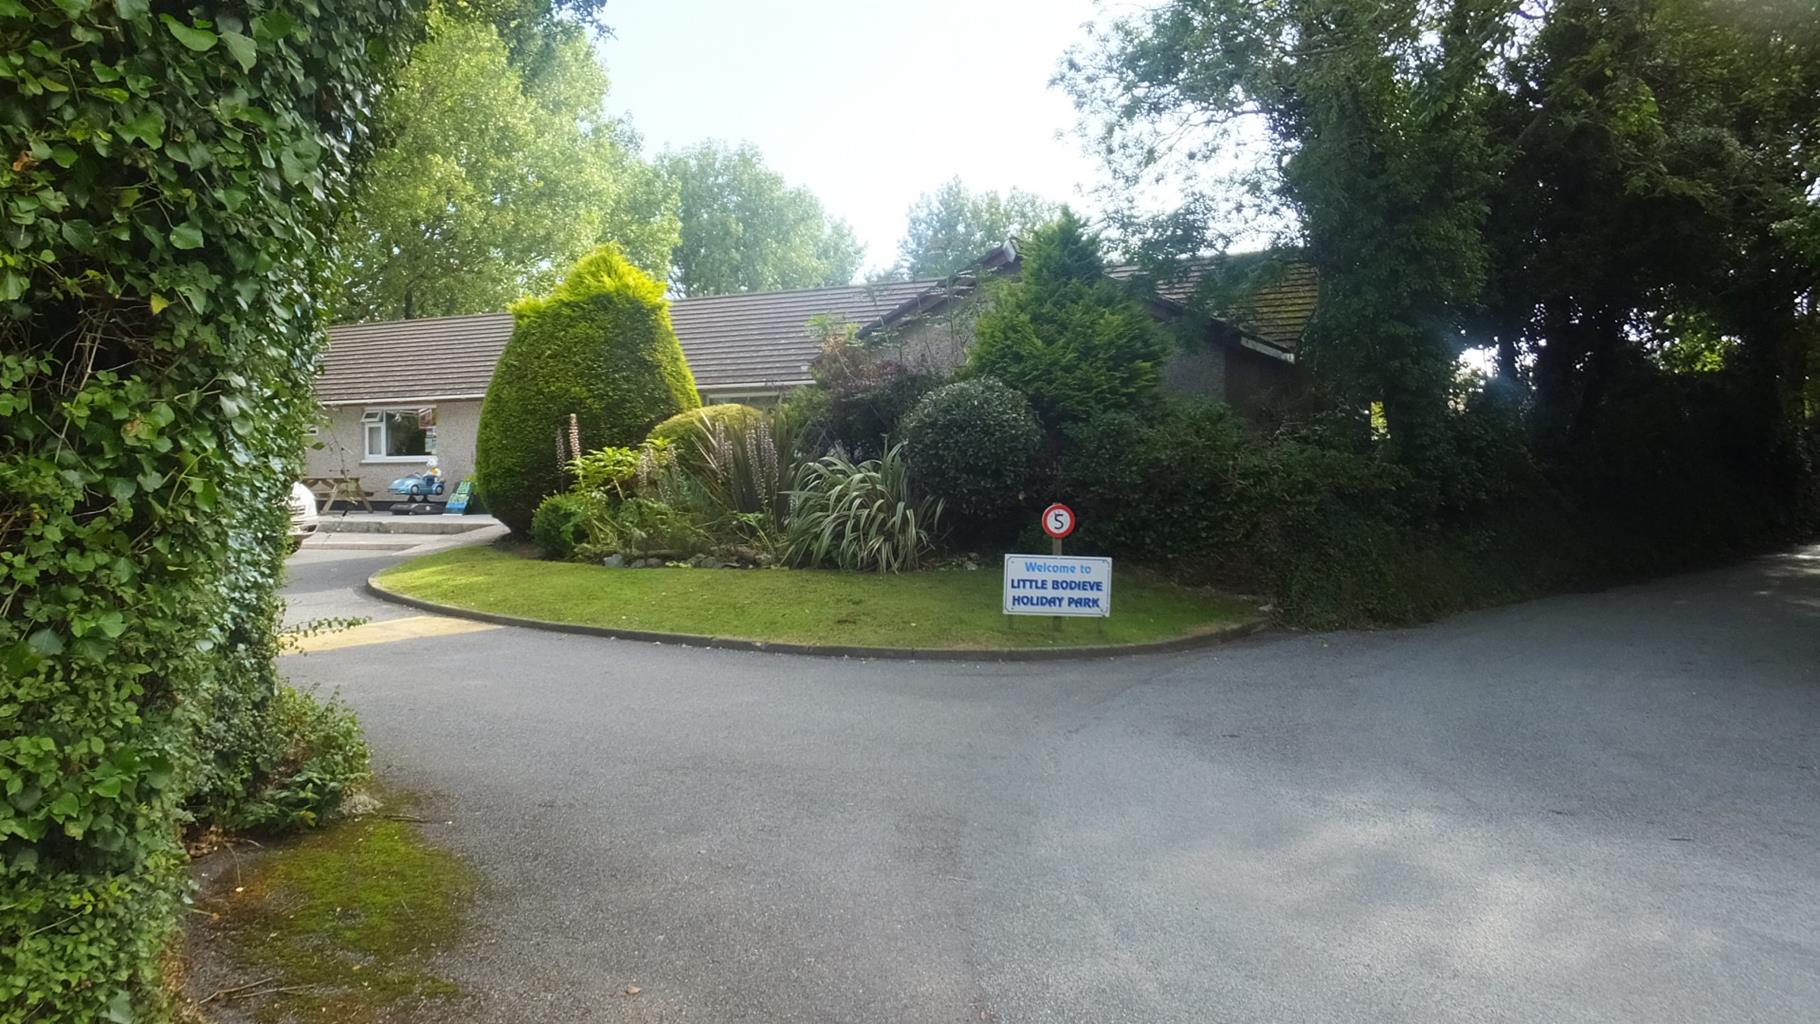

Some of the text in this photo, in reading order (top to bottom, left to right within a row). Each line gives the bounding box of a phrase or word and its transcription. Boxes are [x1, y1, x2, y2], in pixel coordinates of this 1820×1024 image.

[1054, 513, 1064, 530] 5
[1025, 561, 1092, 574] Welcome to
[1011, 578, 1103, 592] LITTLE BODIEVE
[1012, 595, 1100, 609] HOLIDAY PARK
